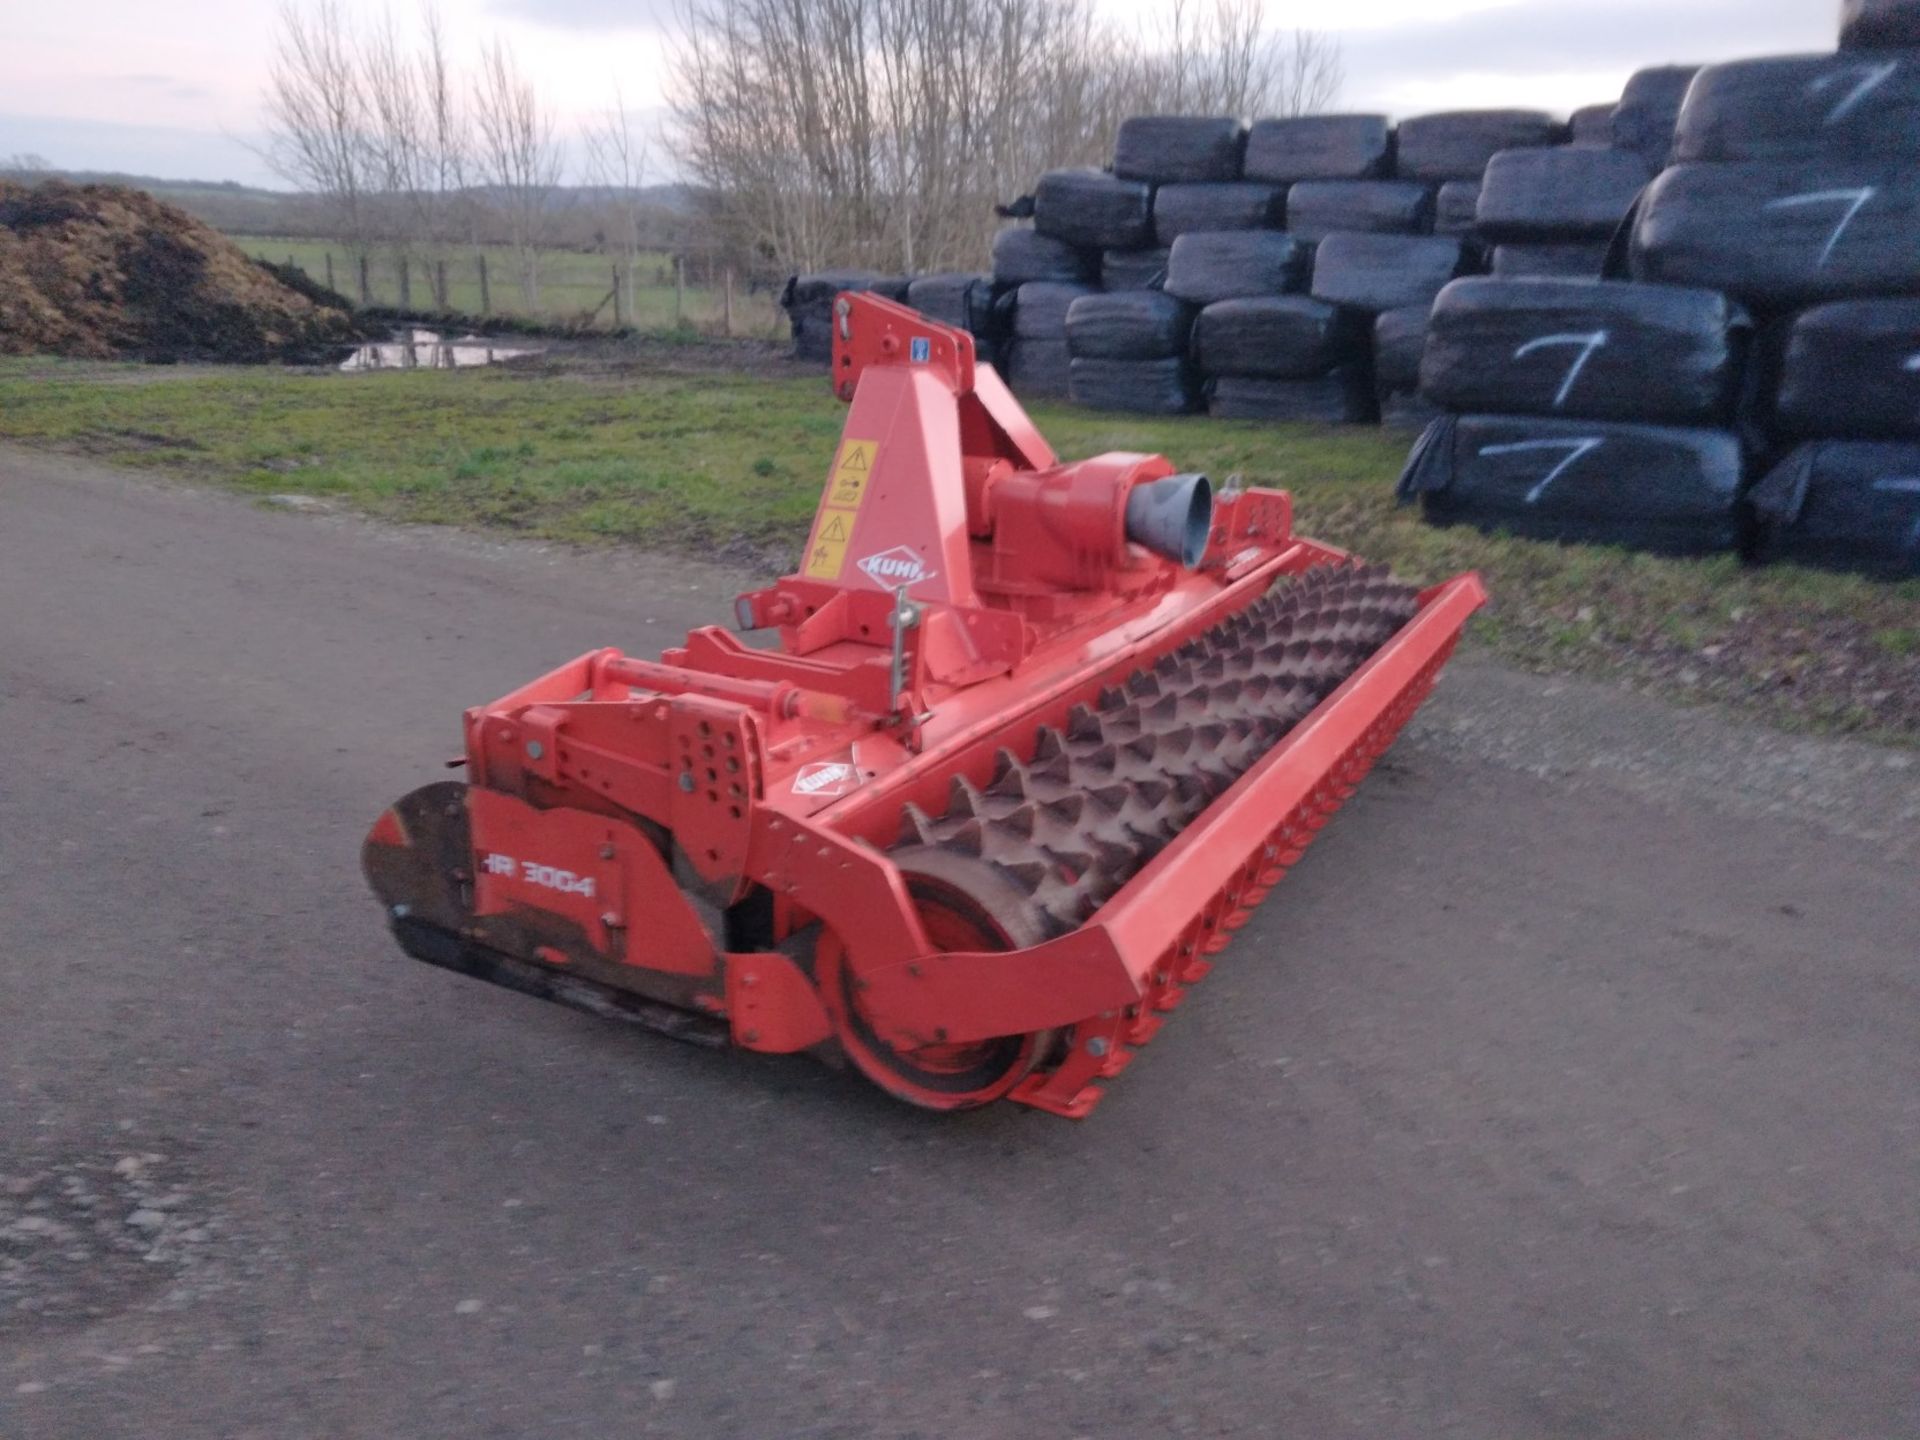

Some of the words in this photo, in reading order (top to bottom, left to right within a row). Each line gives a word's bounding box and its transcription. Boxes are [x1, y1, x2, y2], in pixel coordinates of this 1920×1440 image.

[1810, 59, 1899, 126] 7
[1764, 187, 1876, 268] 7
[1513, 330, 1606, 406] 7
[1479, 437, 1603, 503] 7
